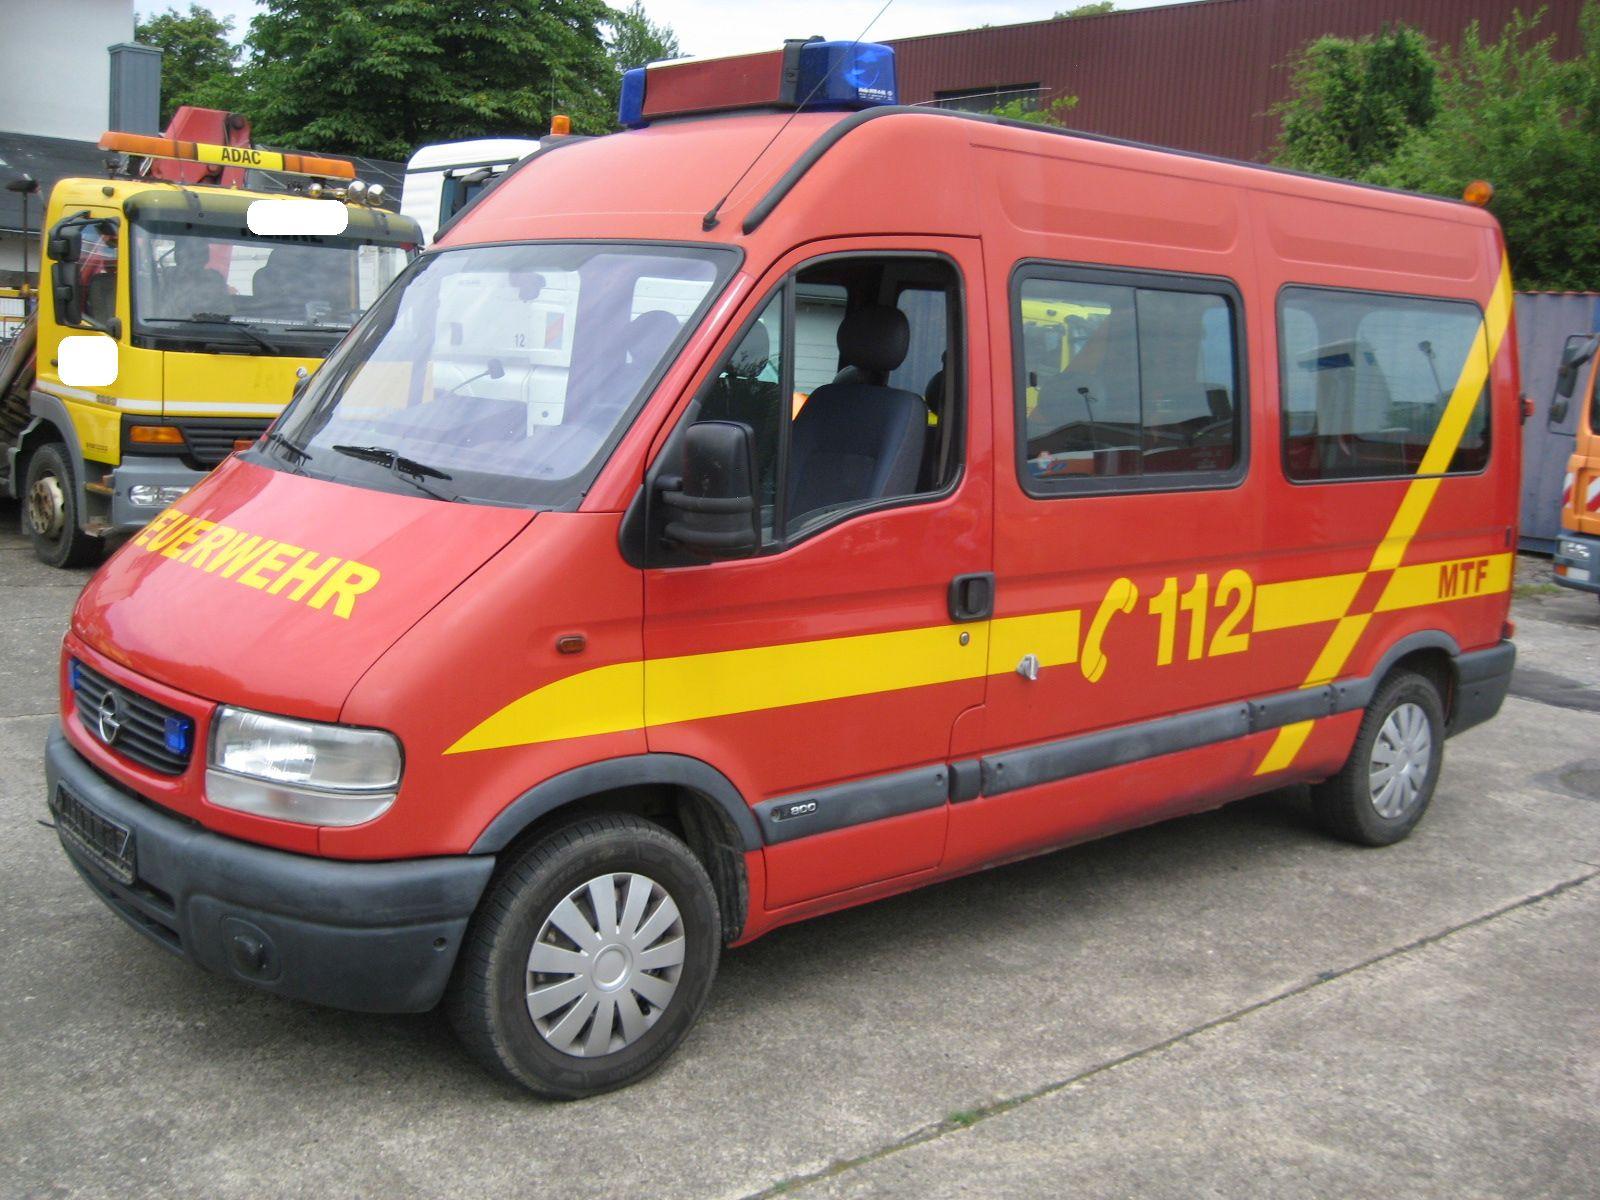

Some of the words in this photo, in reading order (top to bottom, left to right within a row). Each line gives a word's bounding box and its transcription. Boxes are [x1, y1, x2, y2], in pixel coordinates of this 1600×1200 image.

[221, 147, 261, 165] ADAC
[515, 333, 525, 348] 12
[132, 508, 381, 620] EUERWEHR
[1438, 559, 1489, 599] MTF
[1148, 568, 1253, 666] 112
